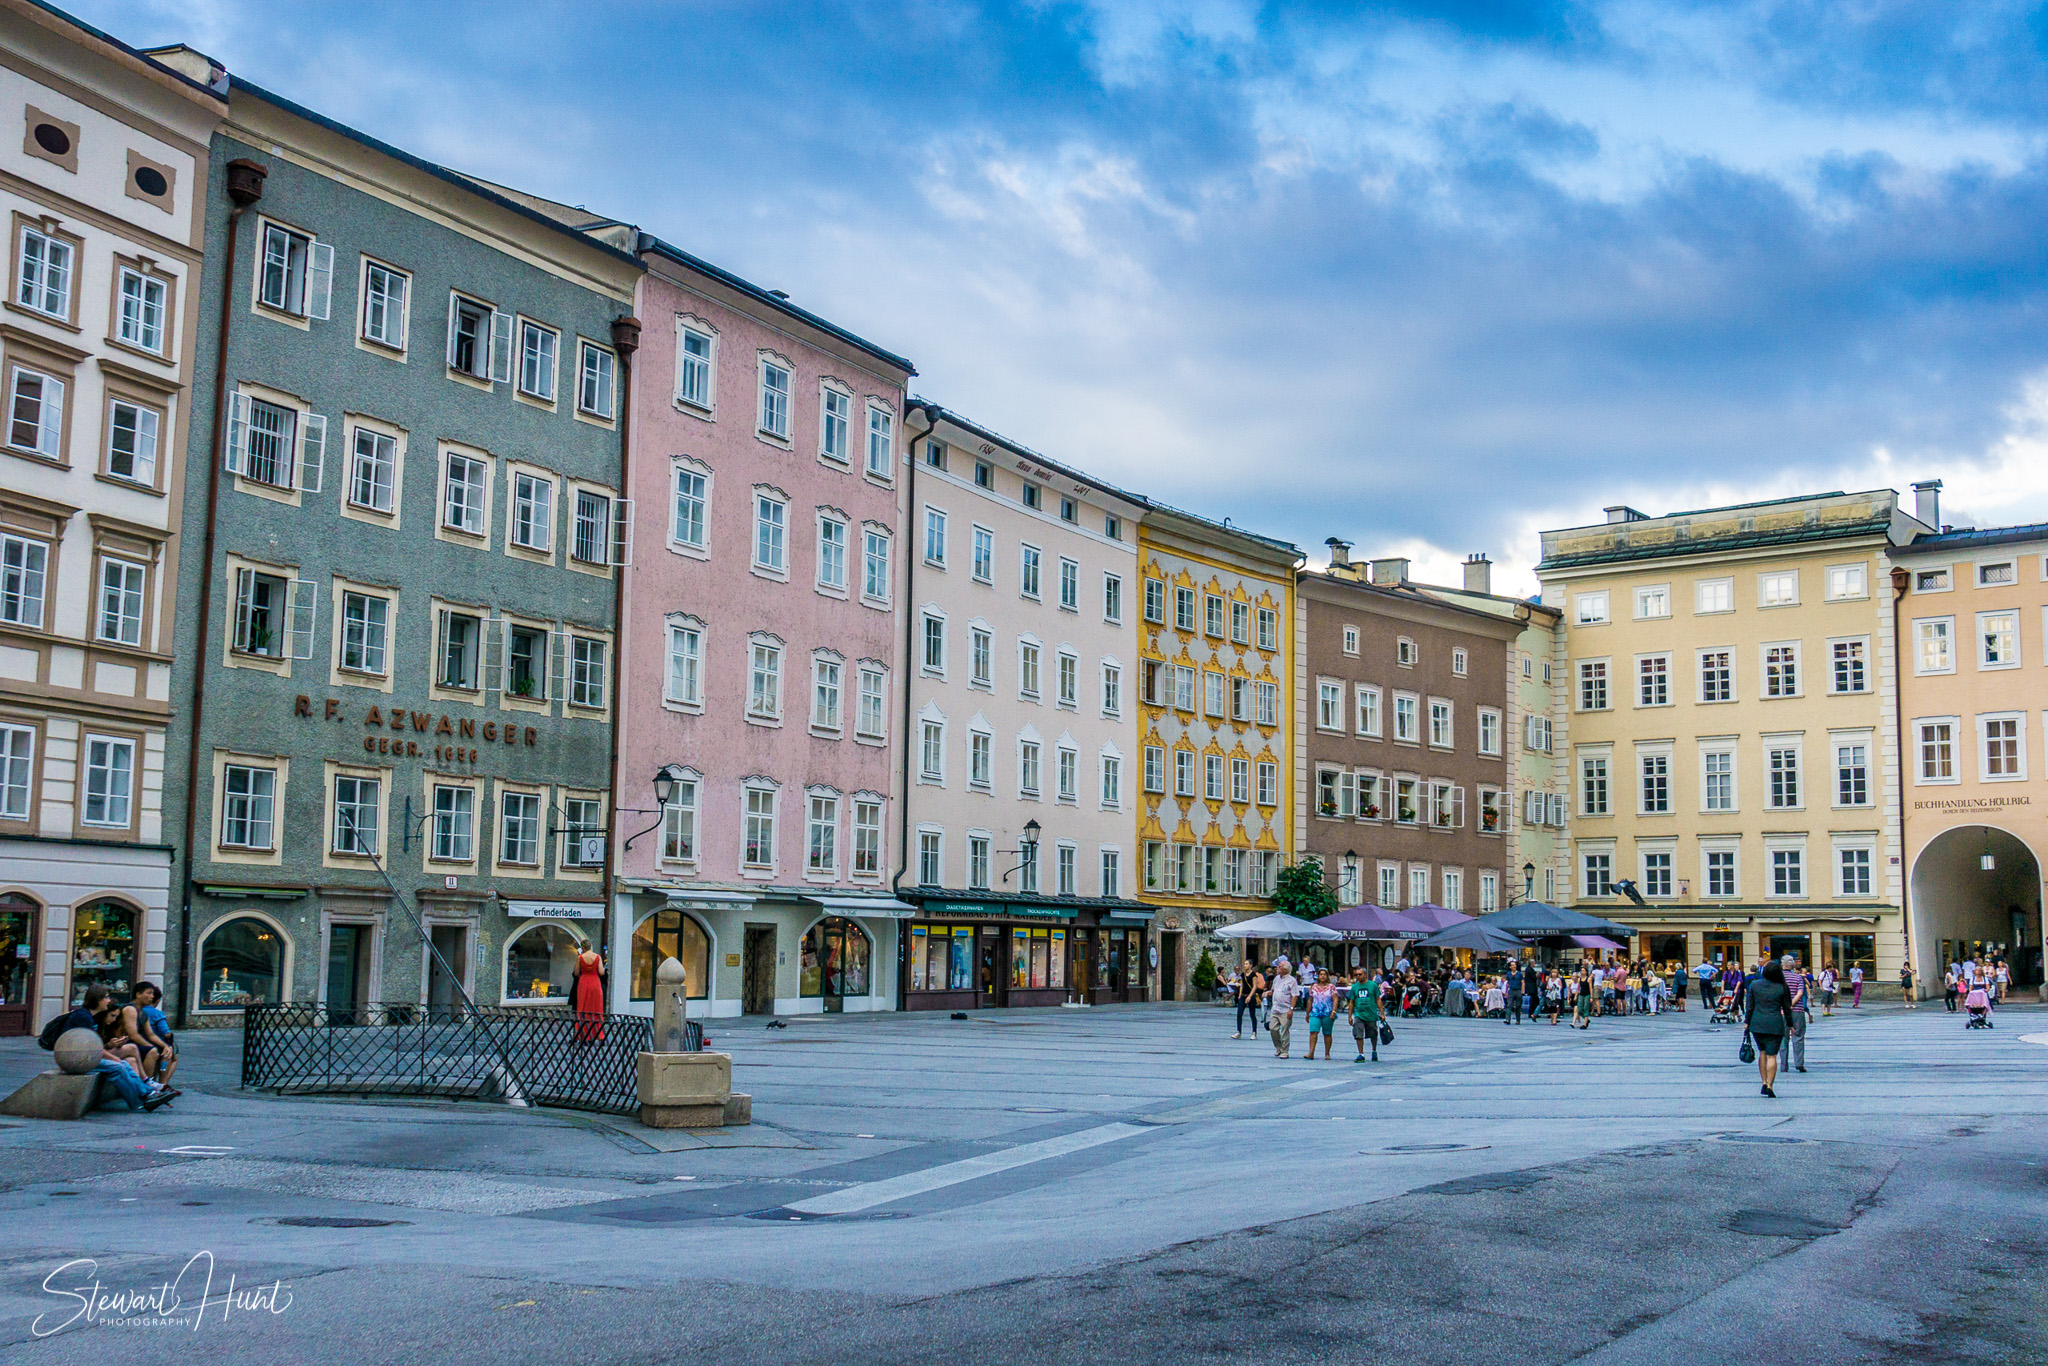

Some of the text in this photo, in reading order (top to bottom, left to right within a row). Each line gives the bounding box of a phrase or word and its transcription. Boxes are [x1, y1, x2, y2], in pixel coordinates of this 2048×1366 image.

[294, 694, 538, 746] R. F. AZWANGER
[364, 736, 479, 764] GEGR. 1656
[1914, 796, 2032, 810] BUCHHANDLUNG HÖLLRIGL
[533, 907, 582, 917] erfinderladen
